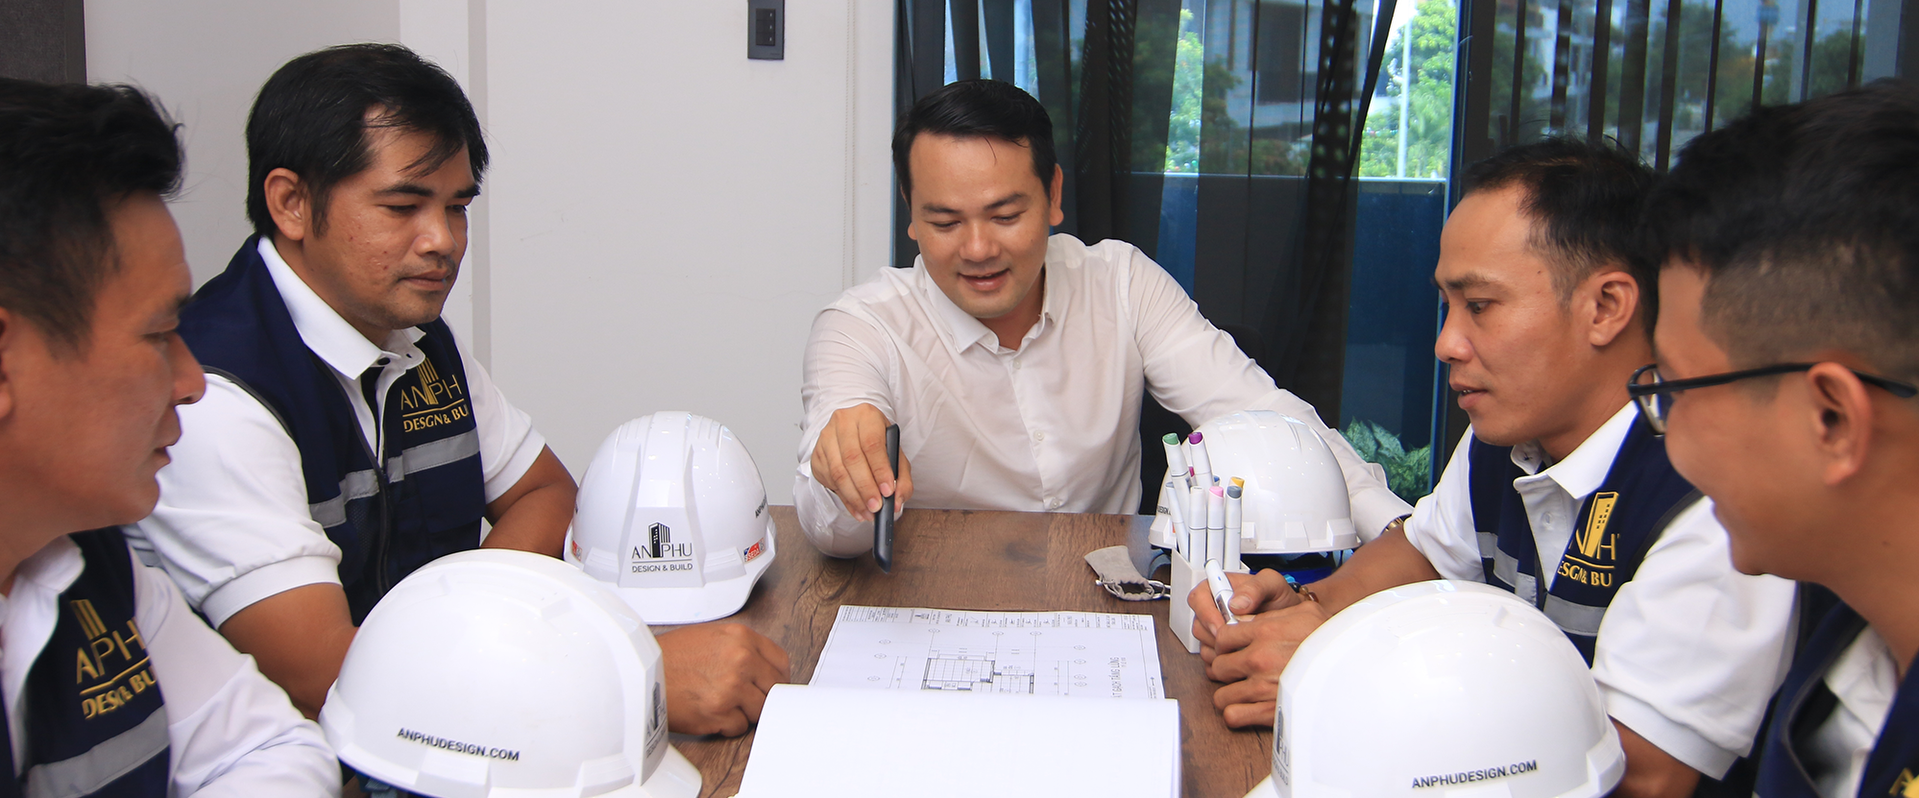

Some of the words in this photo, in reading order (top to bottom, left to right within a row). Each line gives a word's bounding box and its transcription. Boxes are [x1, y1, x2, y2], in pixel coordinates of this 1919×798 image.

[631, 542, 693, 559] ANPHU
[631, 564, 661, 574] DESIGN
[662, 564, 669, 572] &
[669, 562, 693, 571] BUILD
[396, 727, 520, 761] ANPHUDESIGN.COM
[1412, 759, 1538, 788] ANPHUDESIGN.COM
